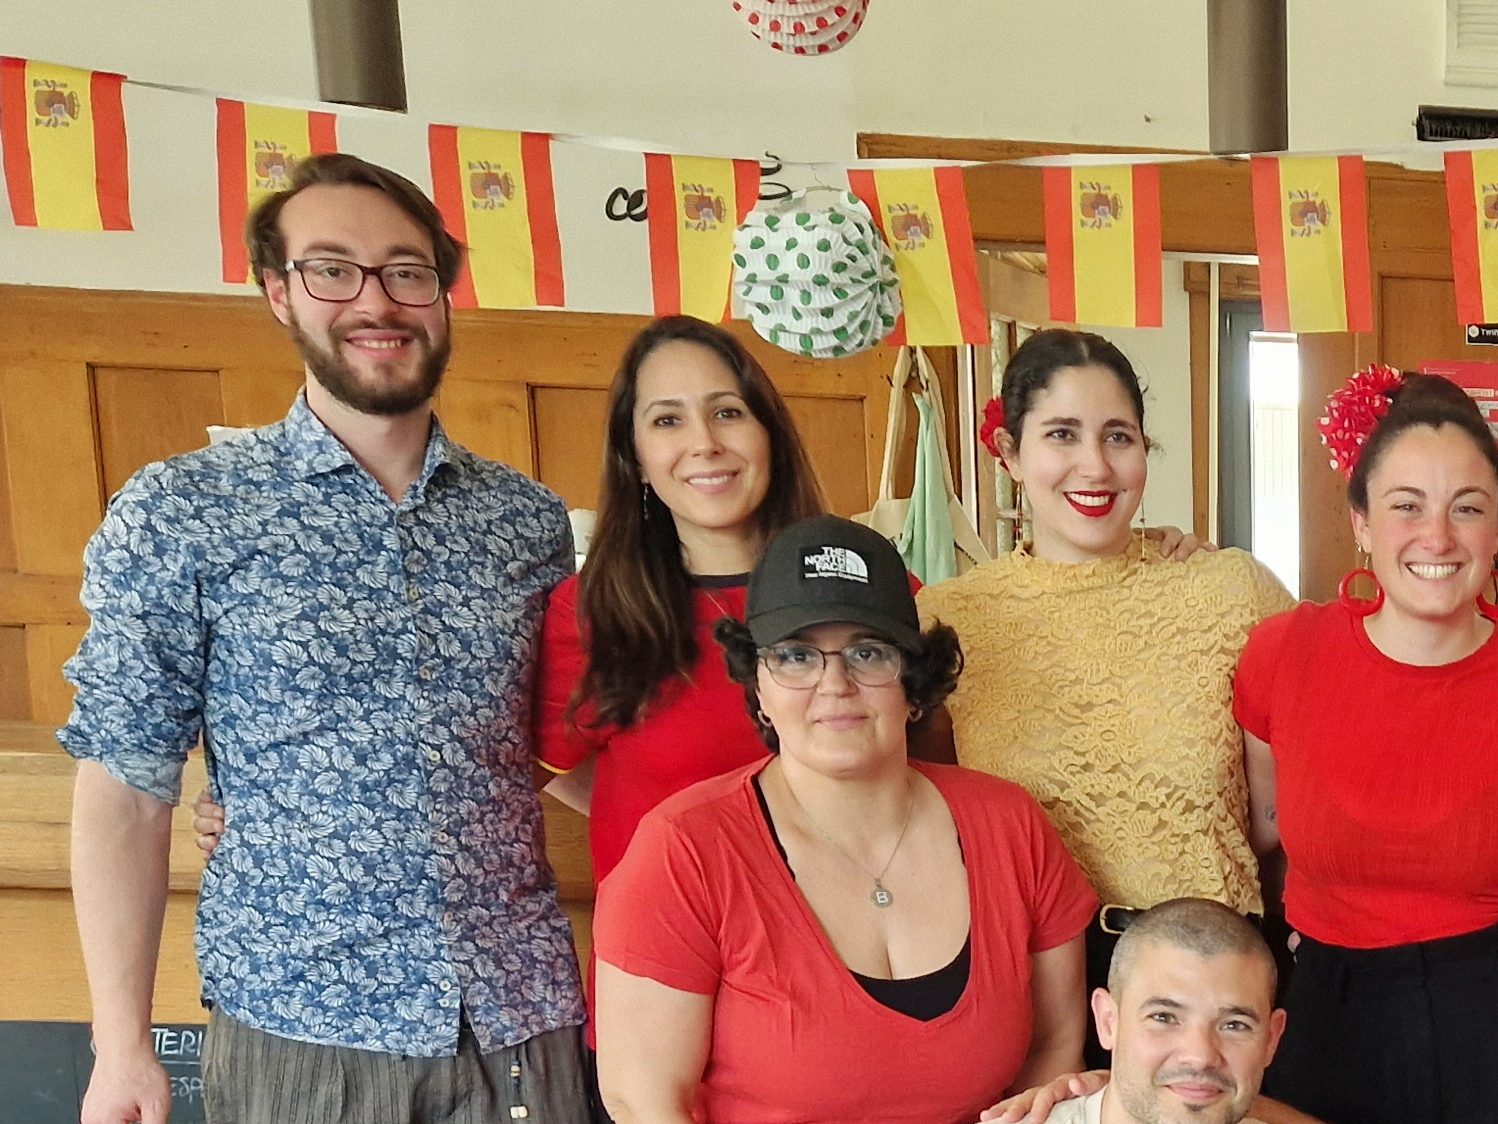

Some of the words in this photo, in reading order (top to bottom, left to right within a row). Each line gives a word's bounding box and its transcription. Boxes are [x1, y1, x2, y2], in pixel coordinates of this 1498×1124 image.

[821, 546, 846, 555] THE
[804, 554, 845, 566] NORTH
[815, 563, 846, 572] FACE
